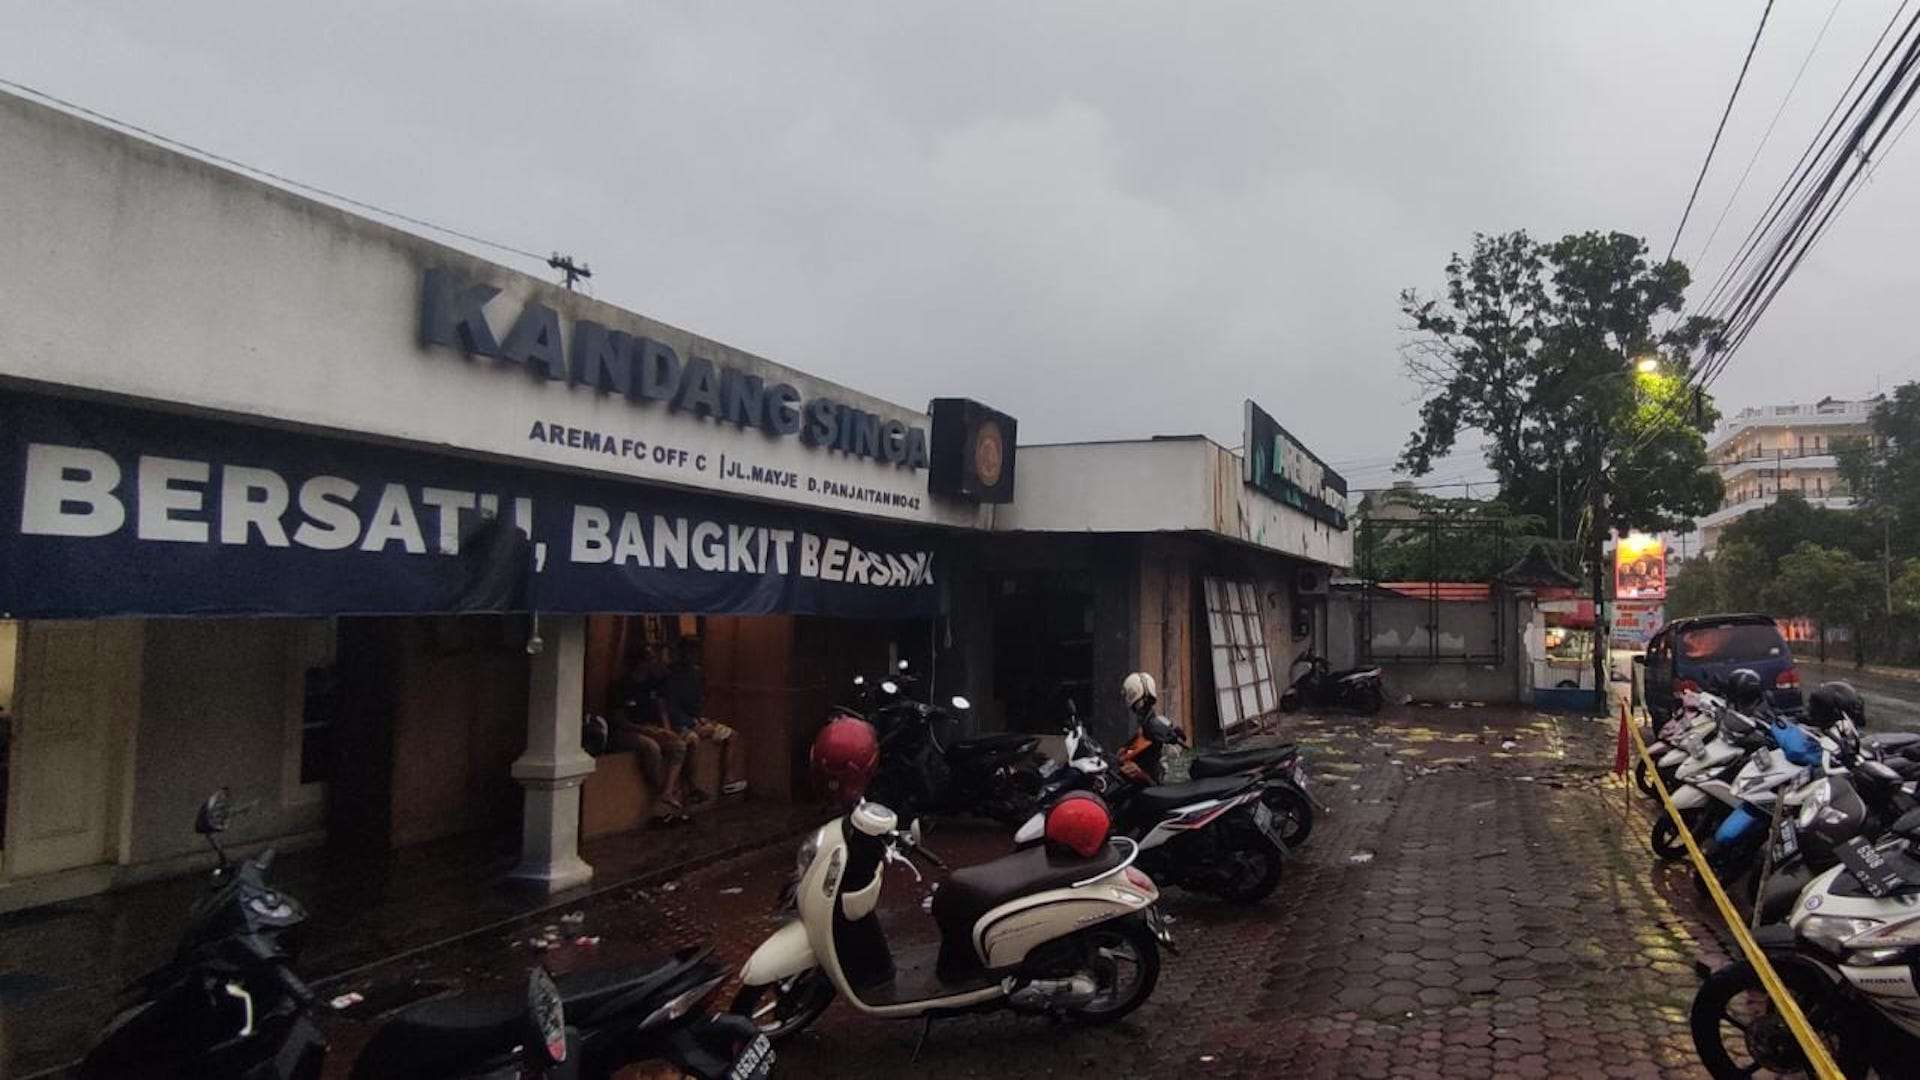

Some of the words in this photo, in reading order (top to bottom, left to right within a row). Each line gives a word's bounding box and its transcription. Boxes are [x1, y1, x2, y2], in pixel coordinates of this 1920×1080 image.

[422, 267, 801, 436] KANDANG
[804, 397, 928, 470] SINGA
[529, 421, 617, 456] AREMA
[622, 439, 647, 460] FC
[570, 504, 794, 574] BANGKIT
